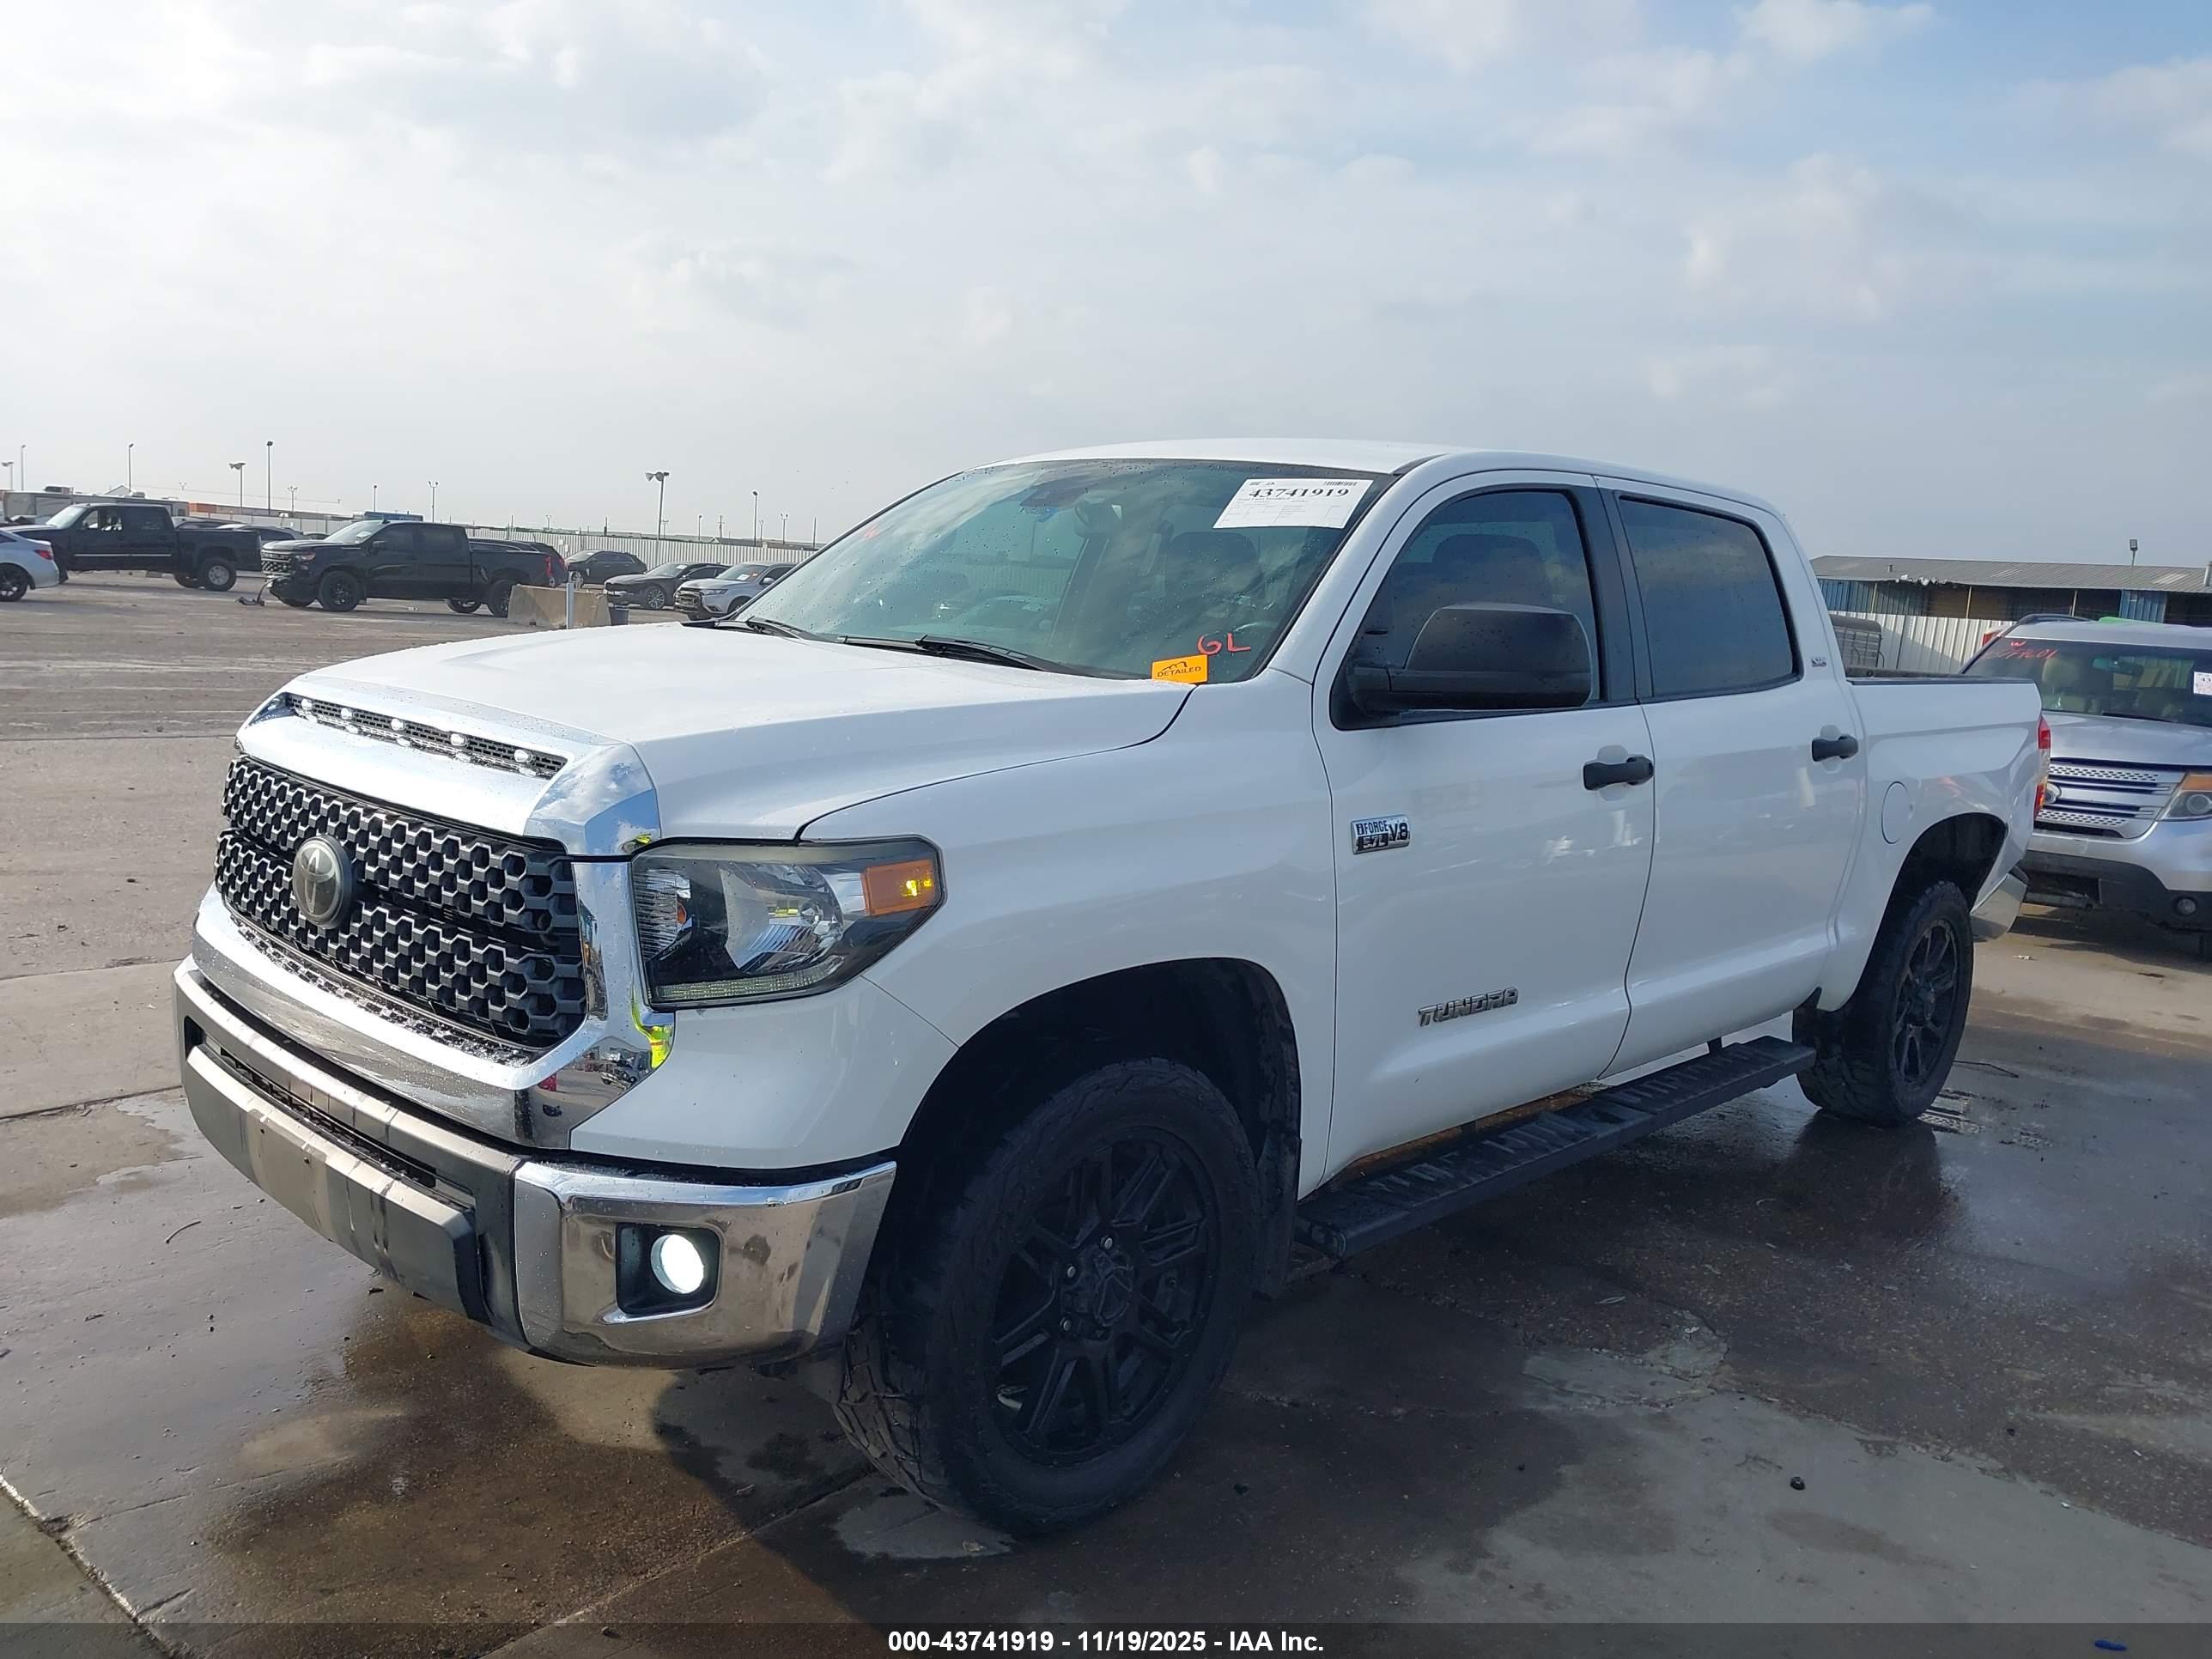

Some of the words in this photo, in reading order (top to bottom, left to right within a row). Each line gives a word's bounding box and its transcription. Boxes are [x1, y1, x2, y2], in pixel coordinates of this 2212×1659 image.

[1249, 488, 1350, 498] 43741919
[1157, 665, 1202, 678] DETAILED
[1389, 822, 1409, 841] V8
[1417, 985, 1519, 1027] TUNDRA
